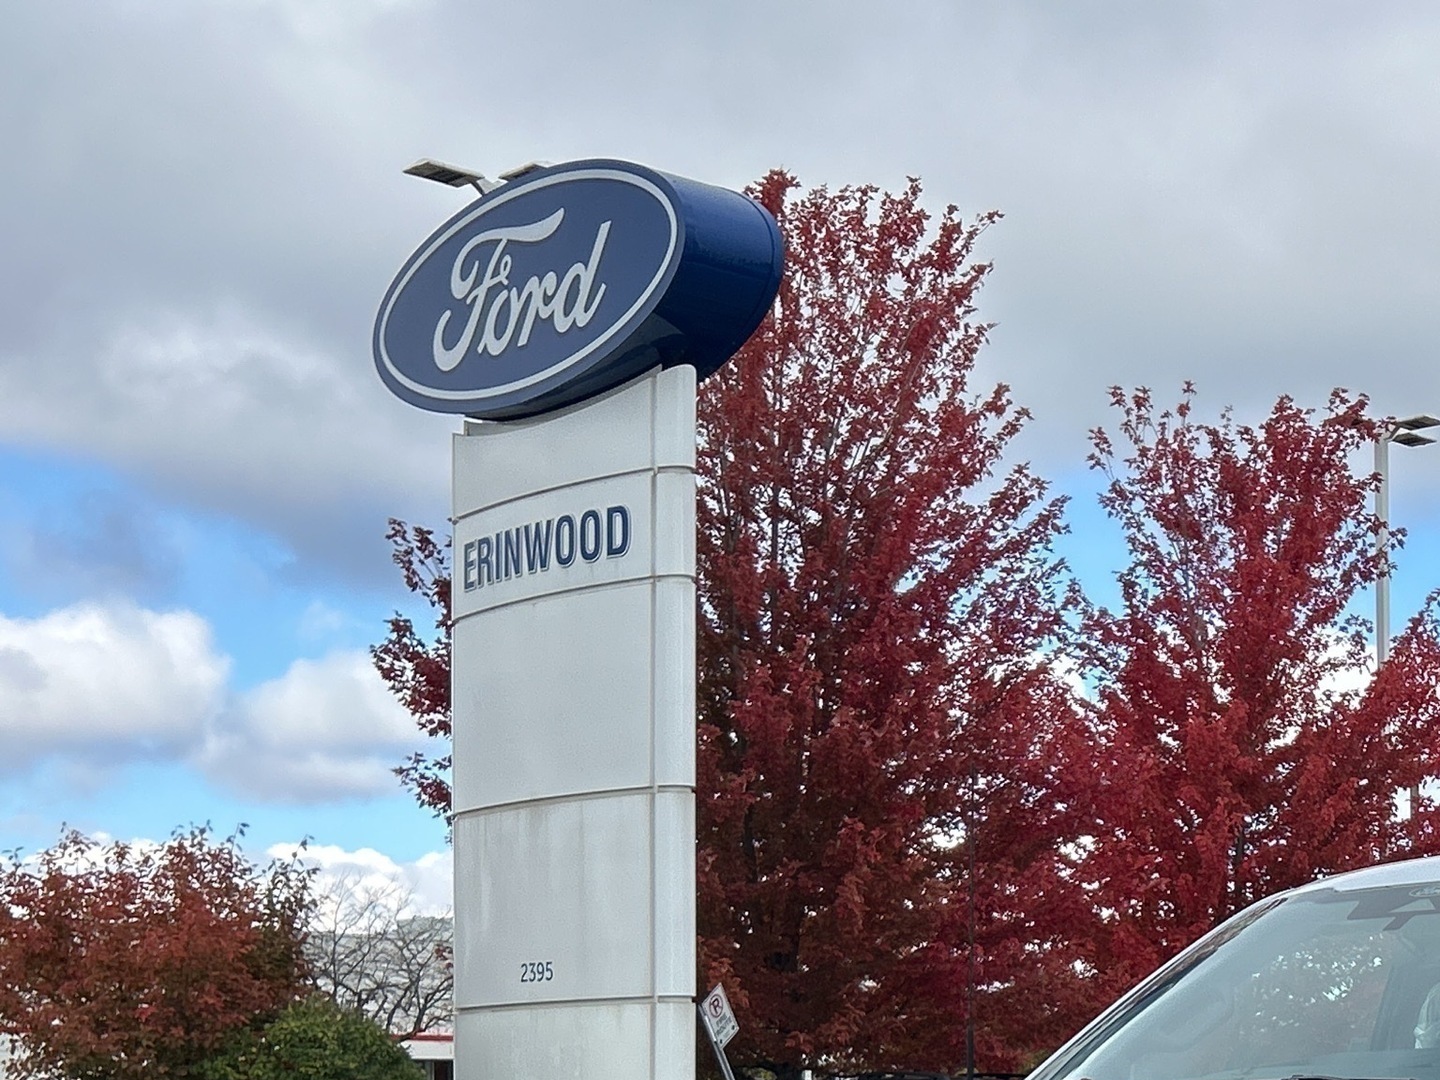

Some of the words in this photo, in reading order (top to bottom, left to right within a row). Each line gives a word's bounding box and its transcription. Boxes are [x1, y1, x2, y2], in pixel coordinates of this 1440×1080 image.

[432, 206, 612, 373] Ford
[463, 504, 634, 593] ERINWOOD
[519, 961, 554, 983] 2395
